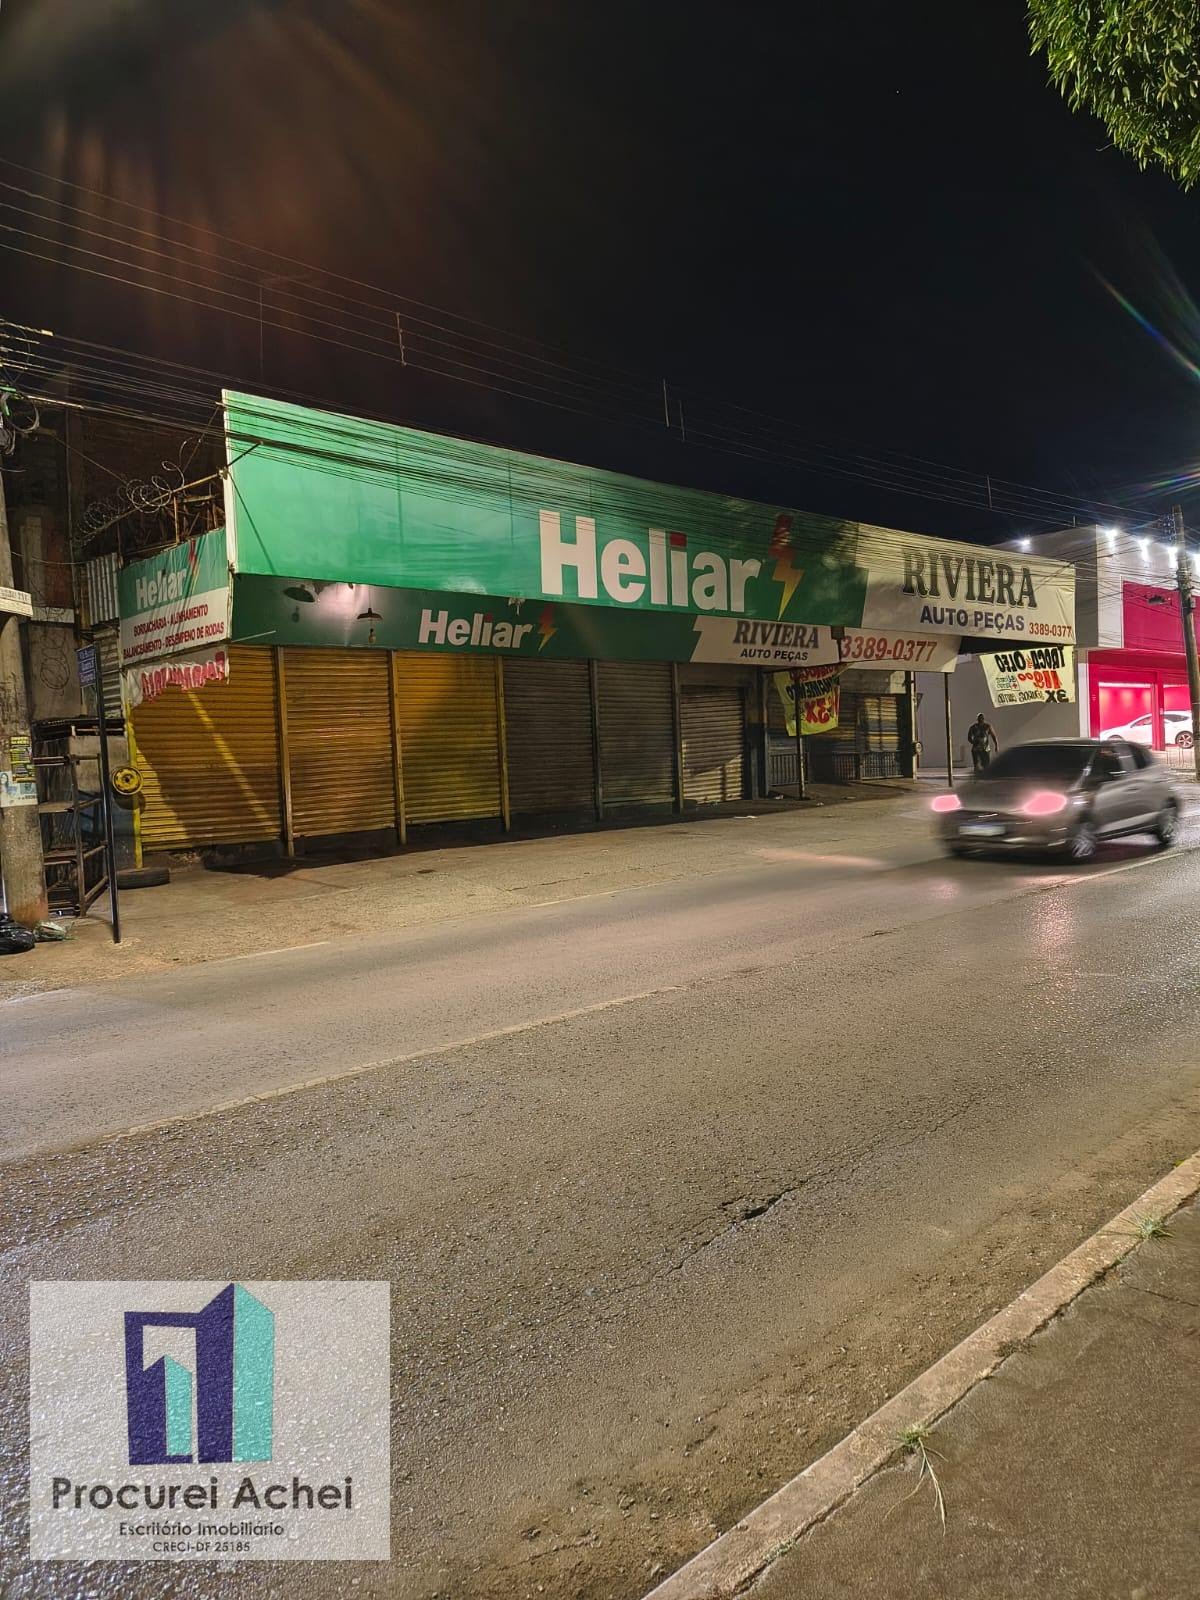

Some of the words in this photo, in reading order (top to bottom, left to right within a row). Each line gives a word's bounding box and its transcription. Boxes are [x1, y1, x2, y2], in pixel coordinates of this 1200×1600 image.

[539, 509, 761, 613] Heliar
[135, 568, 187, 610] Heliar
[902, 549, 1038, 609] RIVIERA
[133, 620, 167, 637] BORRACHARIA
[170, 604, 209, 627] ALINHAMENTO
[204, 622, 225, 637] RODAS
[418, 607, 534, 649] Heliar
[732, 619, 820, 650] RIVIERA
[920, 605, 969, 629] AUTO
[974, 609, 1025, 634] PEÇAS
[1029, 621, 1073, 638] 3389-0377
[740, 647, 770, 660] AUTO
[773, 649, 809, 662] PEÇAS
[840, 635, 938, 662] 3389-0377
